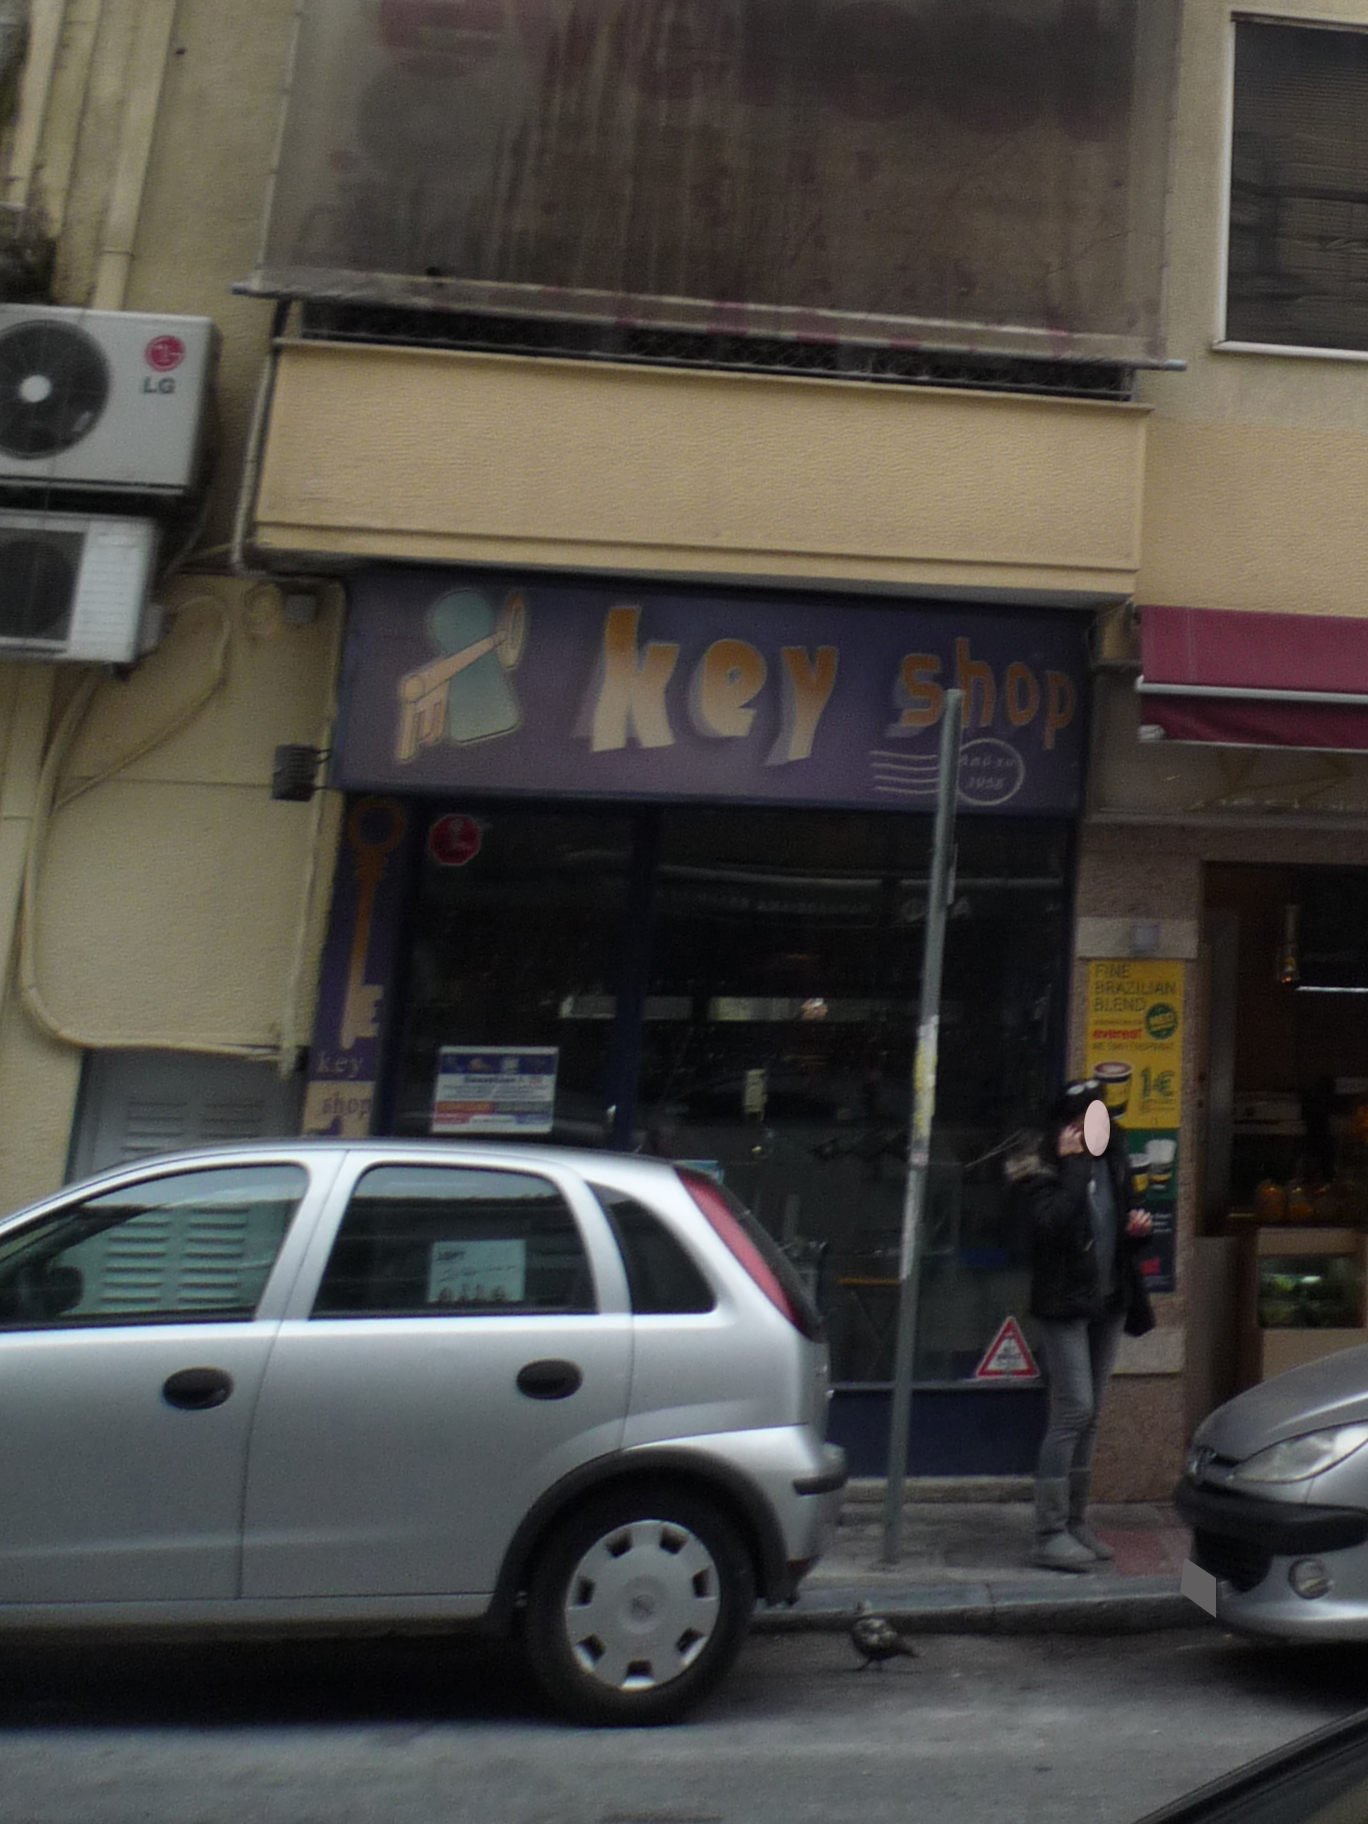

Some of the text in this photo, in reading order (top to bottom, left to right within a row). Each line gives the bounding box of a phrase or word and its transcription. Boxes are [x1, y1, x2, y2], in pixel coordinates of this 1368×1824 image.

[143, 376, 176, 394] LG
[592, 606, 1076, 762] key shop
[1094, 980, 1176, 995] BRAZILIAN
[1094, 997, 1147, 1012] BLEND
[1093, 1028, 1142, 1040] everest
[317, 1050, 363, 1079] key
